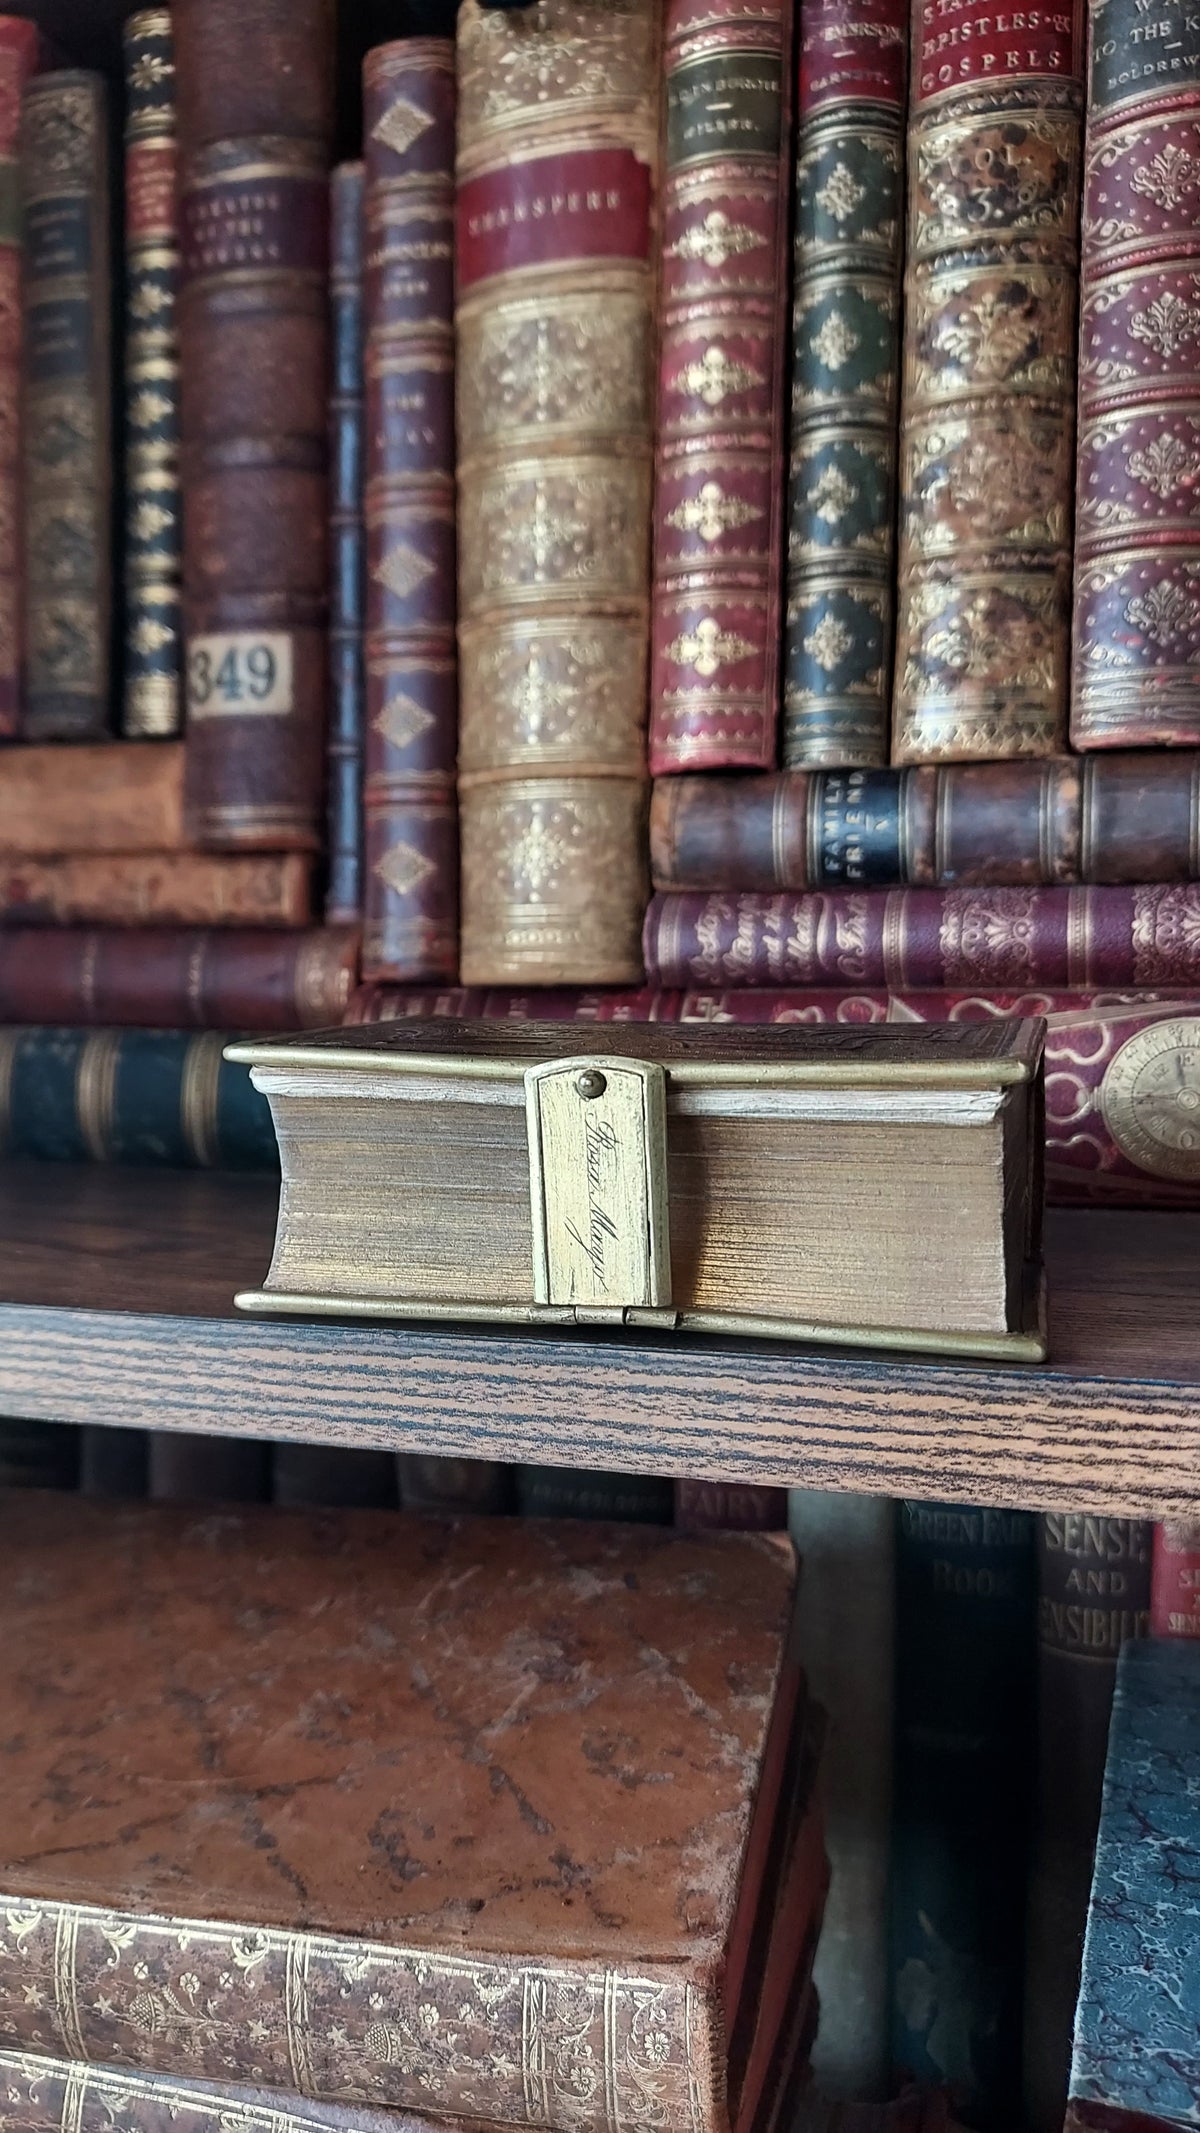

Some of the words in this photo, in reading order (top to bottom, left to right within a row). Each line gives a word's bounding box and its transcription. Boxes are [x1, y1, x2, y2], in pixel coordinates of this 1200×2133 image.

[922, 11, 1040, 60] EPISTLES
[1129, 20, 1172, 45] THE
[921, 50, 1062, 92] GOSPELS
[190, 645, 277, 704] 349
[824, 777, 842, 871] FAMILY
[845, 771, 865, 878] FRIEND
[585, 1112, 623, 1192] Rosa
[564, 1192, 620, 1293] Mayo
[1065, 1568, 1127, 1595] AND
